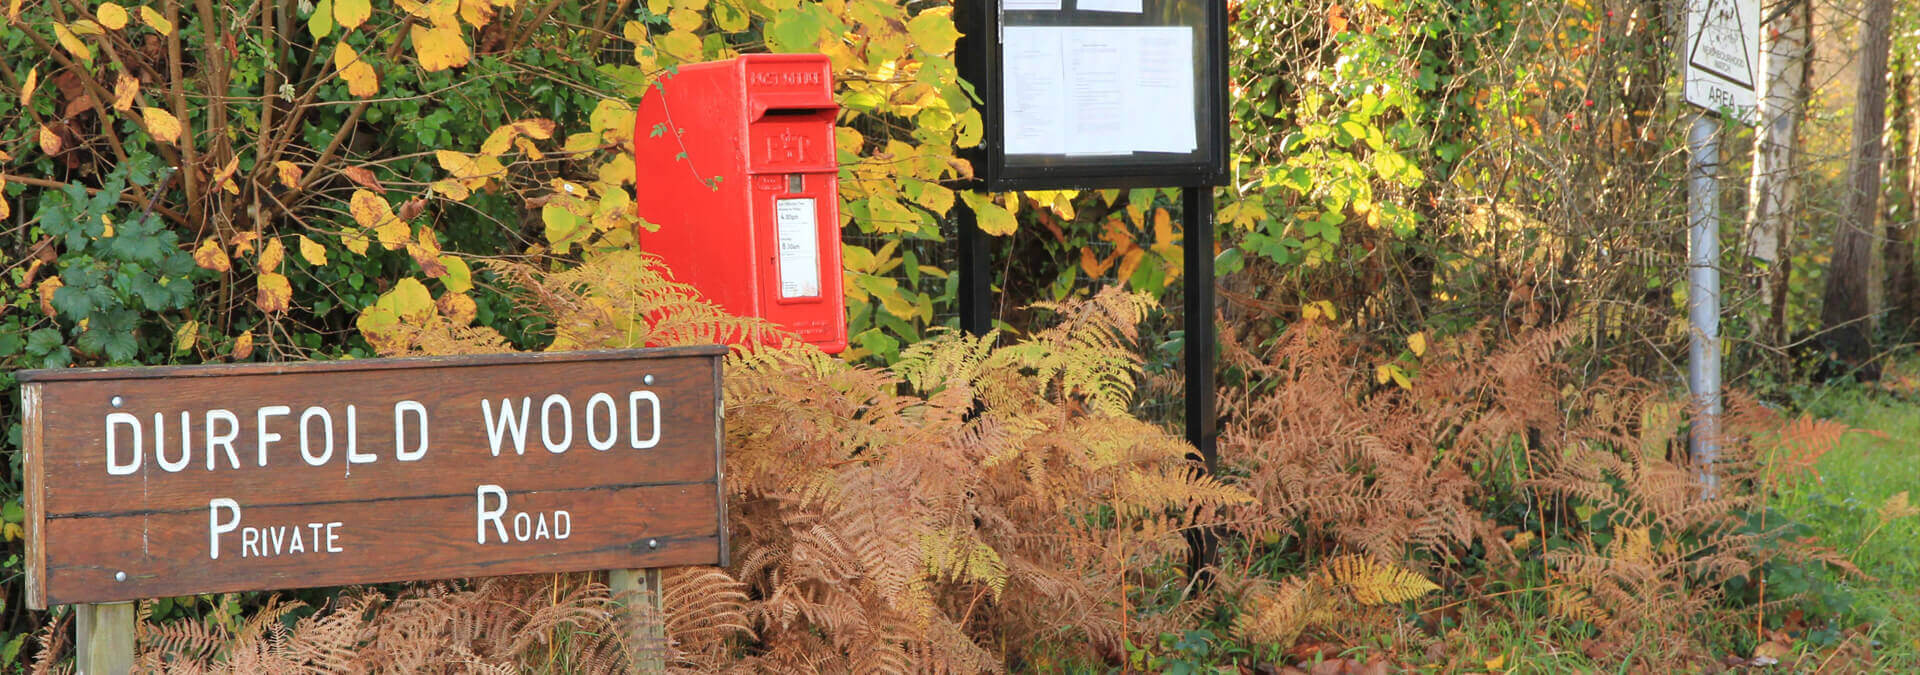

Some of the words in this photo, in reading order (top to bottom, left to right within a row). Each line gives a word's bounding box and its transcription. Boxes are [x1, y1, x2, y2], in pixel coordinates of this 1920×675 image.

[1708, 86, 1735, 111] AREA
[105, 399, 429, 476] DURFOLD
[481, 390, 661, 457] WOOD
